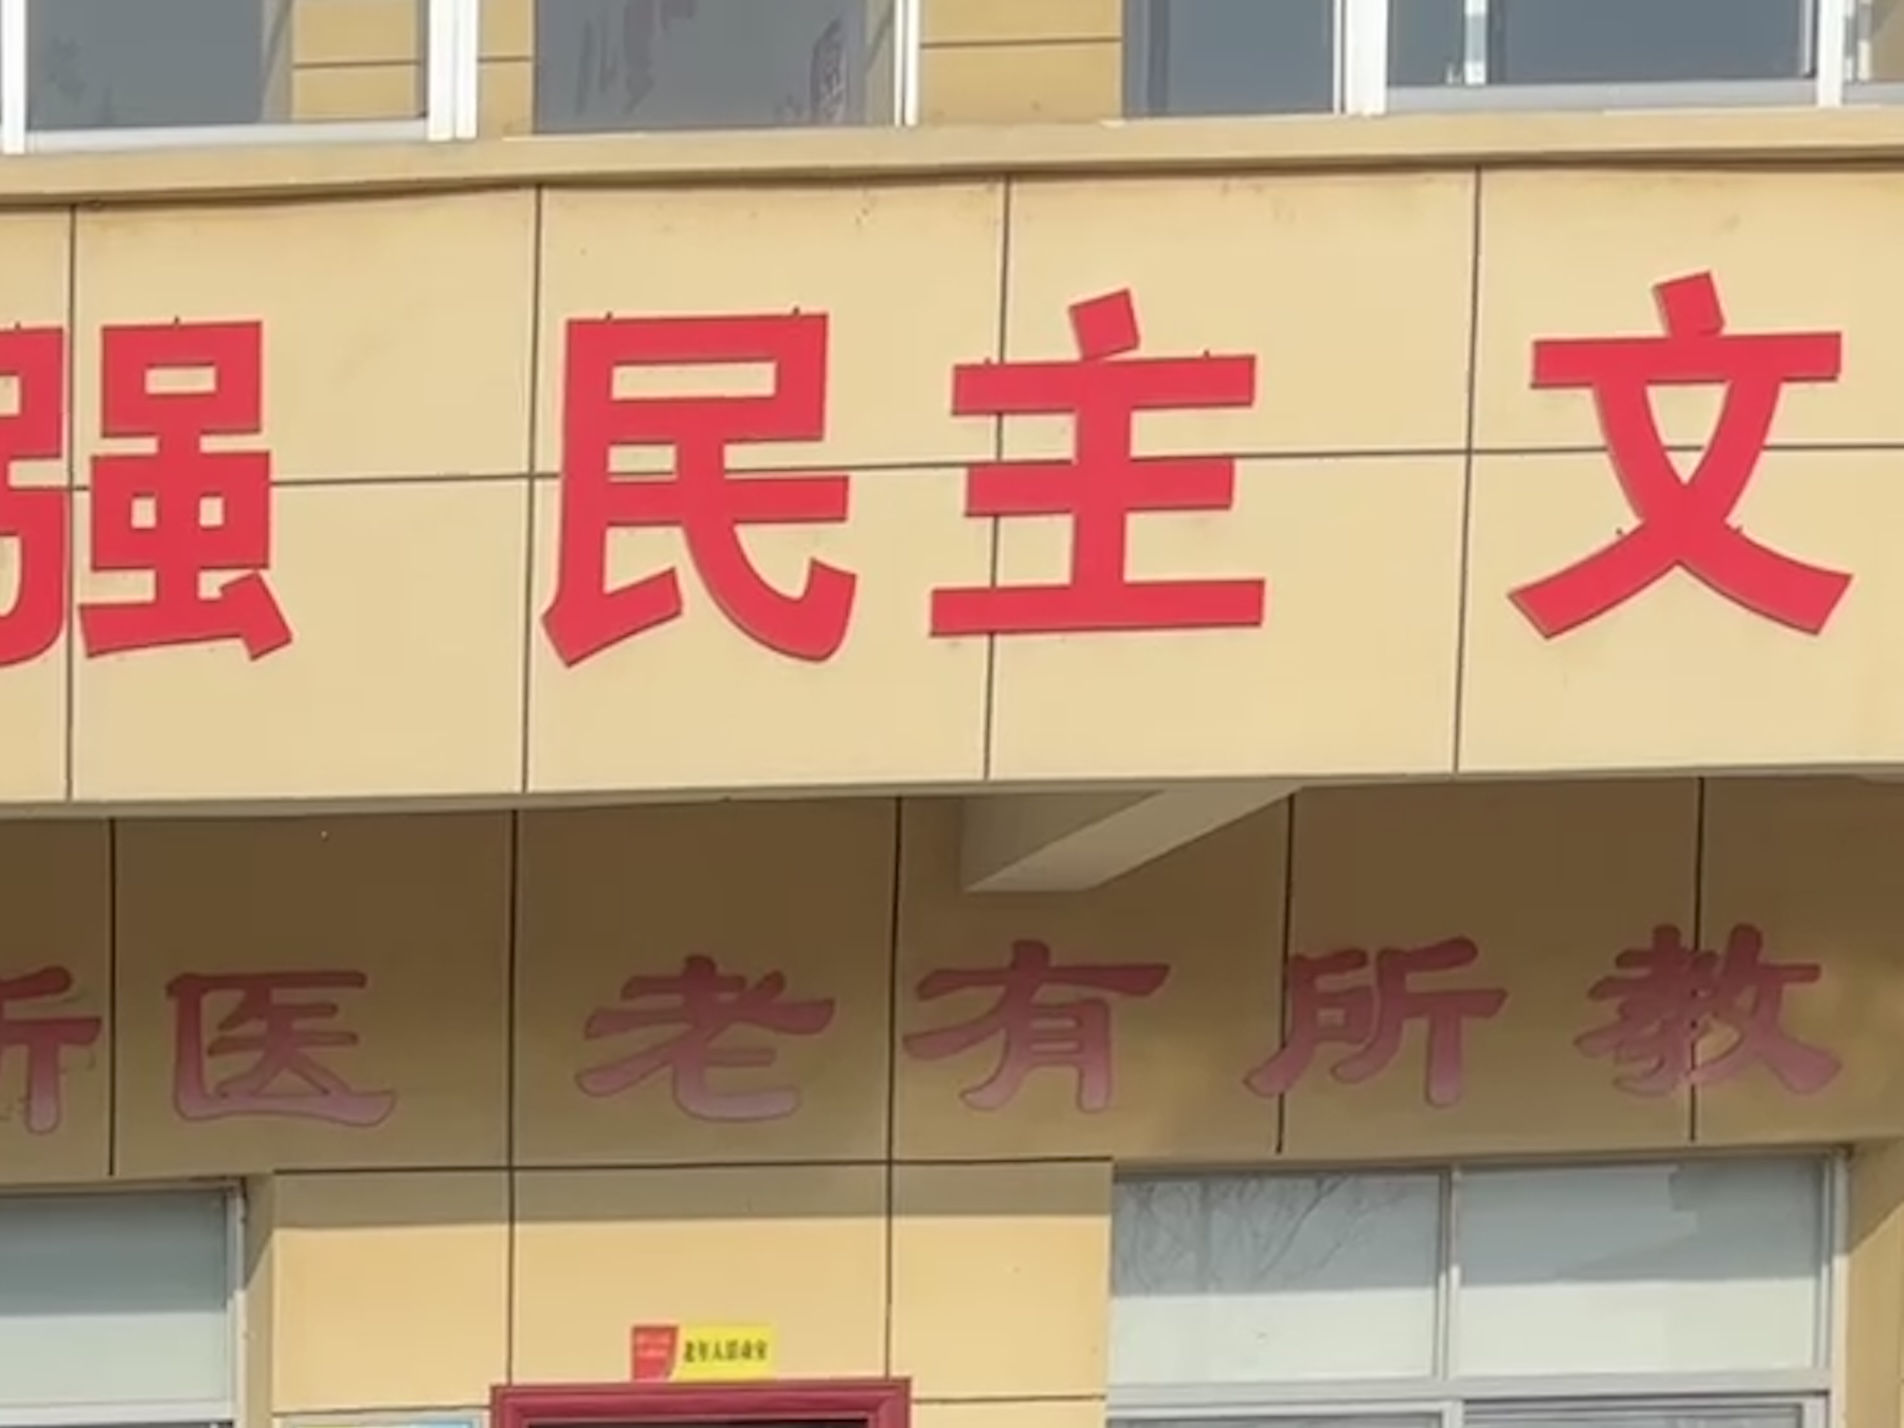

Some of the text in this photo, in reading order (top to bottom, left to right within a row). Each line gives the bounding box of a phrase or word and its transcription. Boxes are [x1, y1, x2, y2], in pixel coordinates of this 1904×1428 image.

[540, 288, 1267, 668] 民主
[1506, 271, 1855, 639] 文
[575, 922, 1844, 1124] 老有所教
